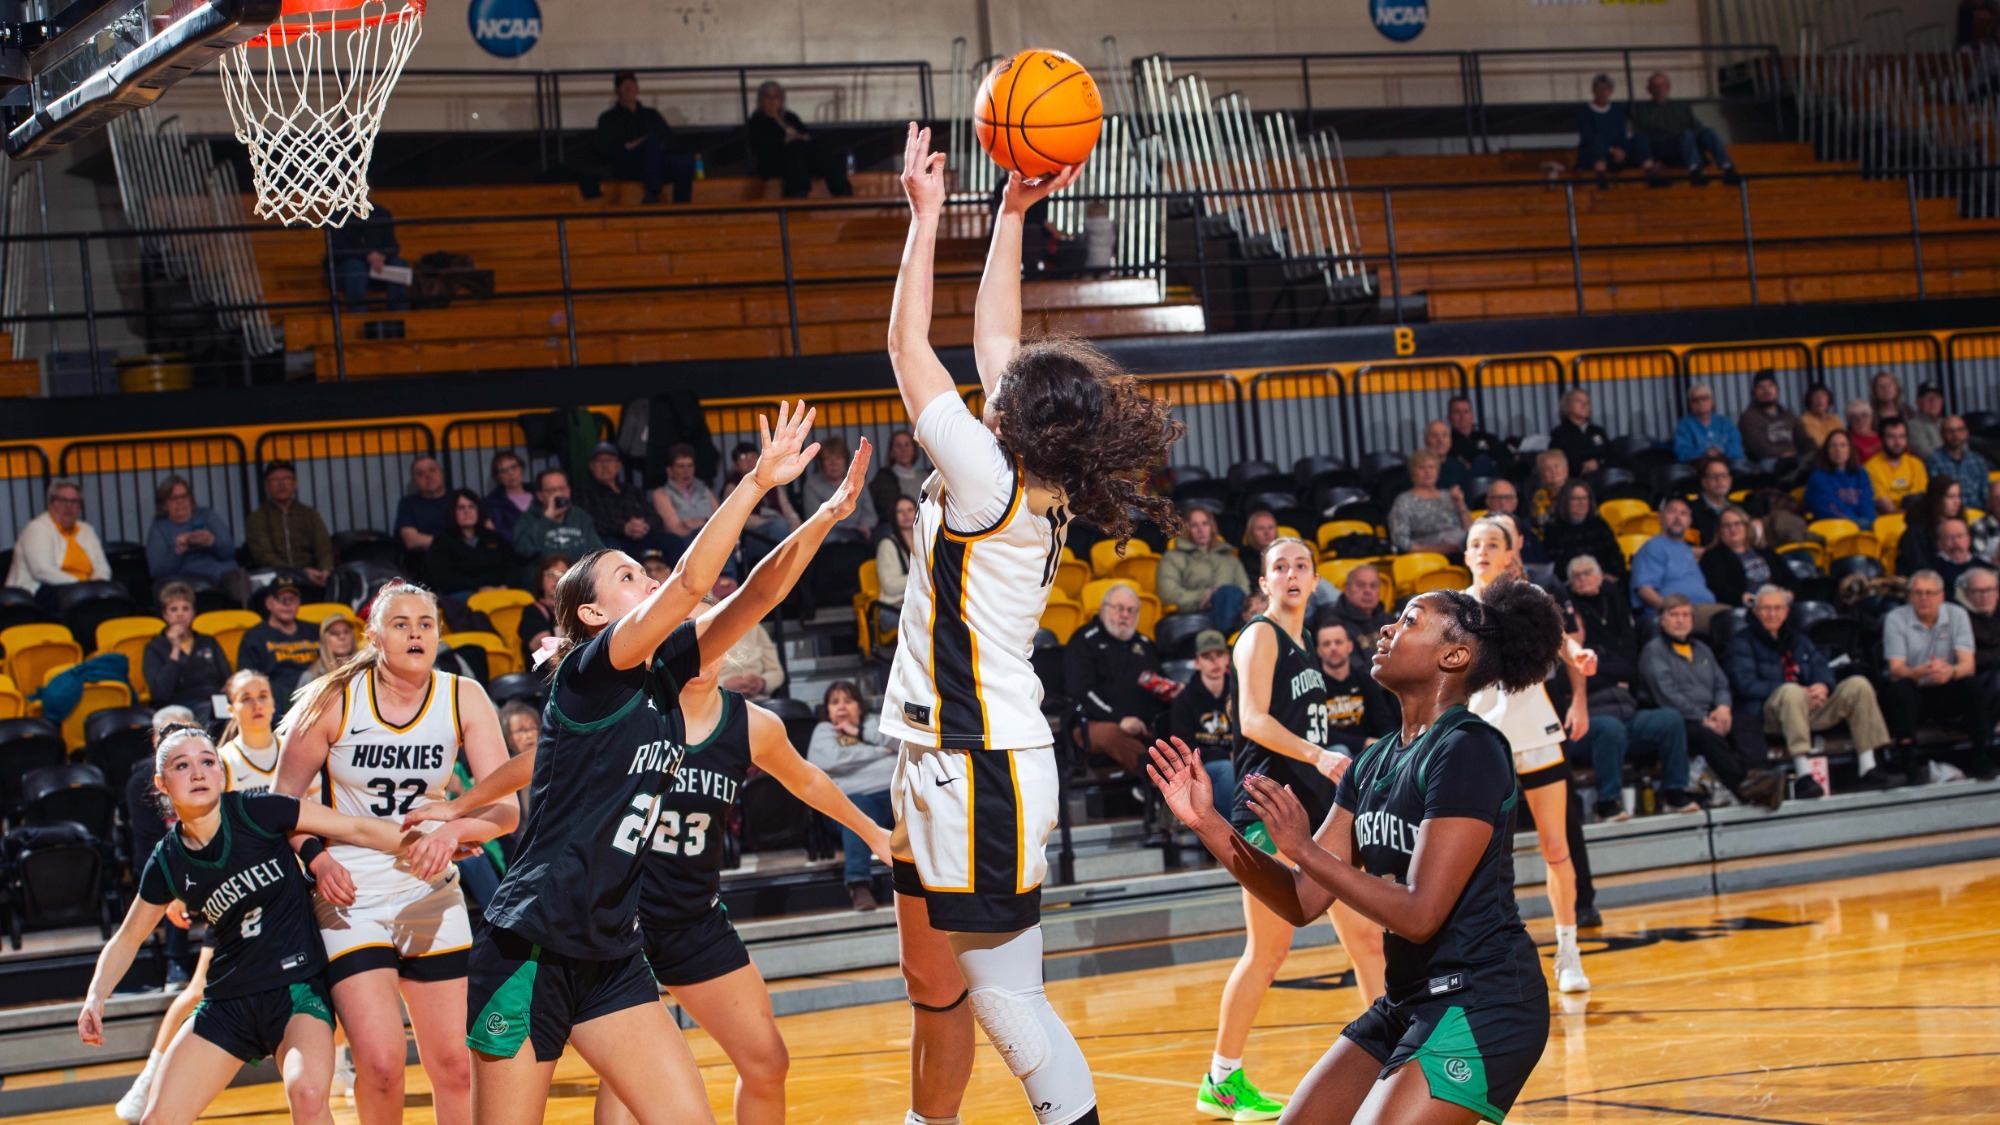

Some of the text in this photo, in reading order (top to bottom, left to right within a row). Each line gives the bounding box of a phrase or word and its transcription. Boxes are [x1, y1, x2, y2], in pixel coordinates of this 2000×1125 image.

[476, 18, 540, 40] NCAA
[1376, 6, 1427, 26] NCAA
[1394, 327, 1416, 355] B
[351, 744, 444, 769] HUSKIES
[367, 777, 428, 817] 32
[669, 767, 737, 805] SEVELT
[651, 811, 711, 857] 23
